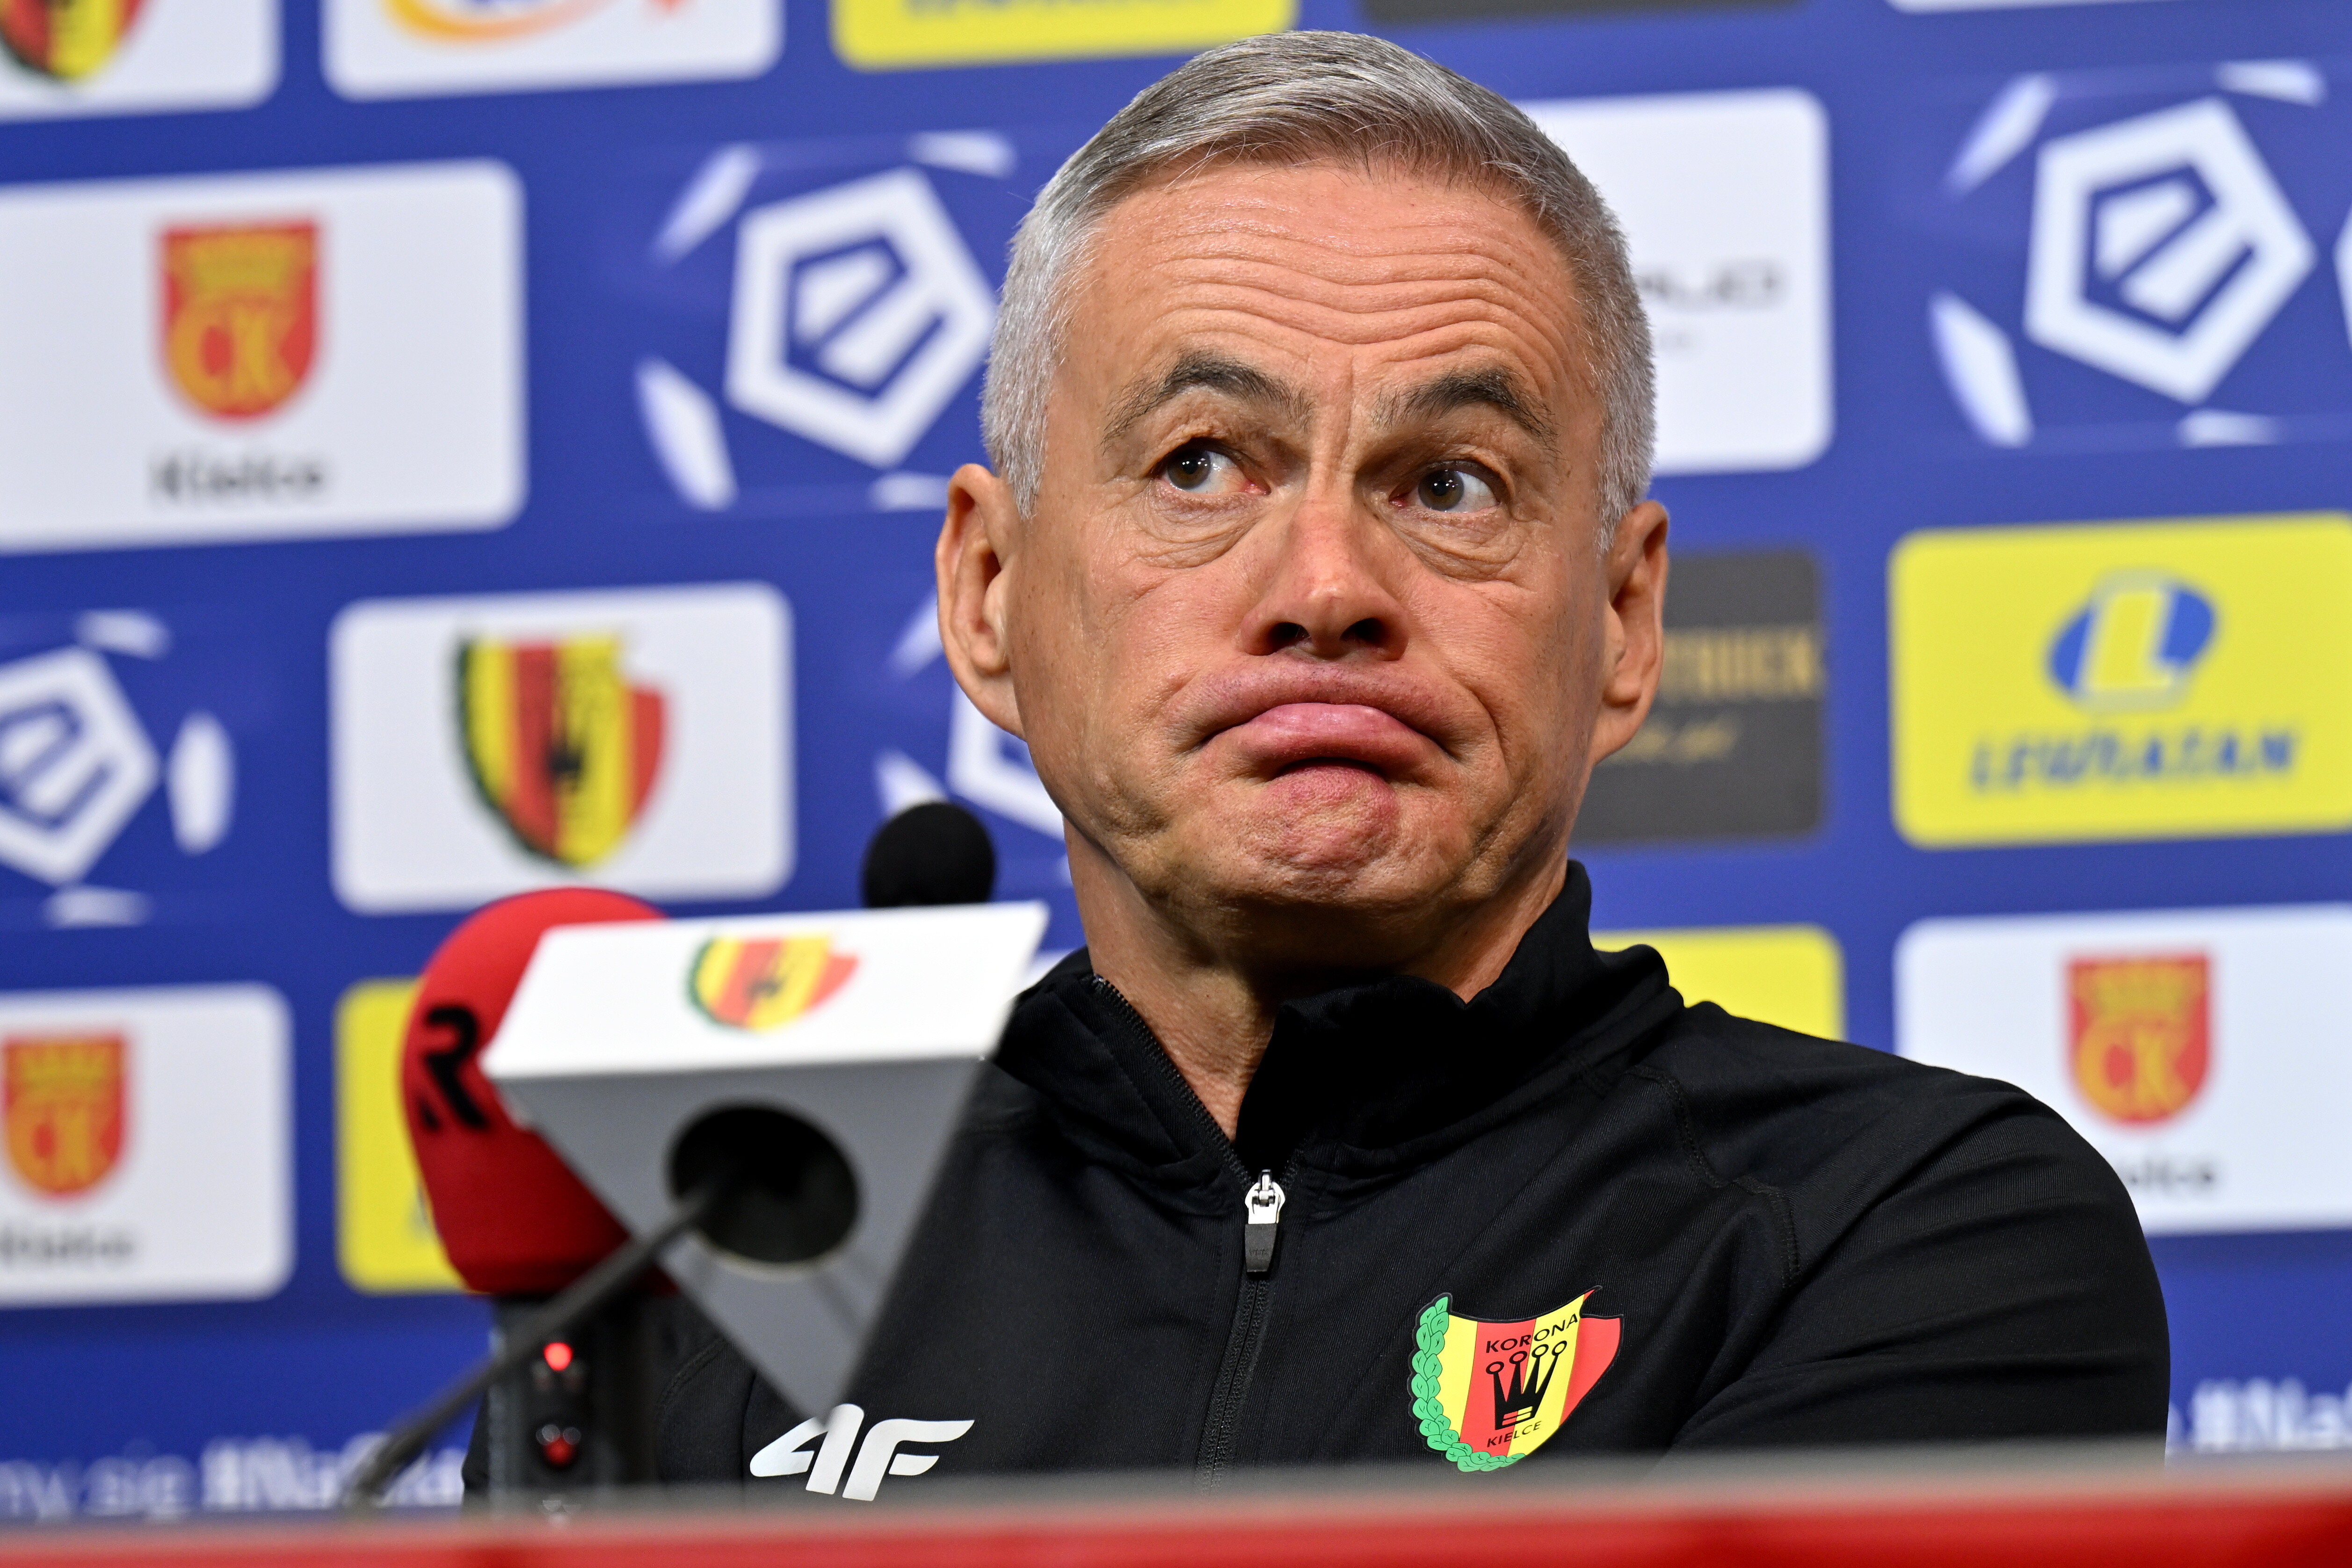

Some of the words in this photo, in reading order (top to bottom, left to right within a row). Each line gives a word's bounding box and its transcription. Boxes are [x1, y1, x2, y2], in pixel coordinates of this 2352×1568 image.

[1486, 1313, 1578, 1353] KORONA
[749, 1403, 975, 1502] 4F
[1486, 1420, 1542, 1448] KIELCE
